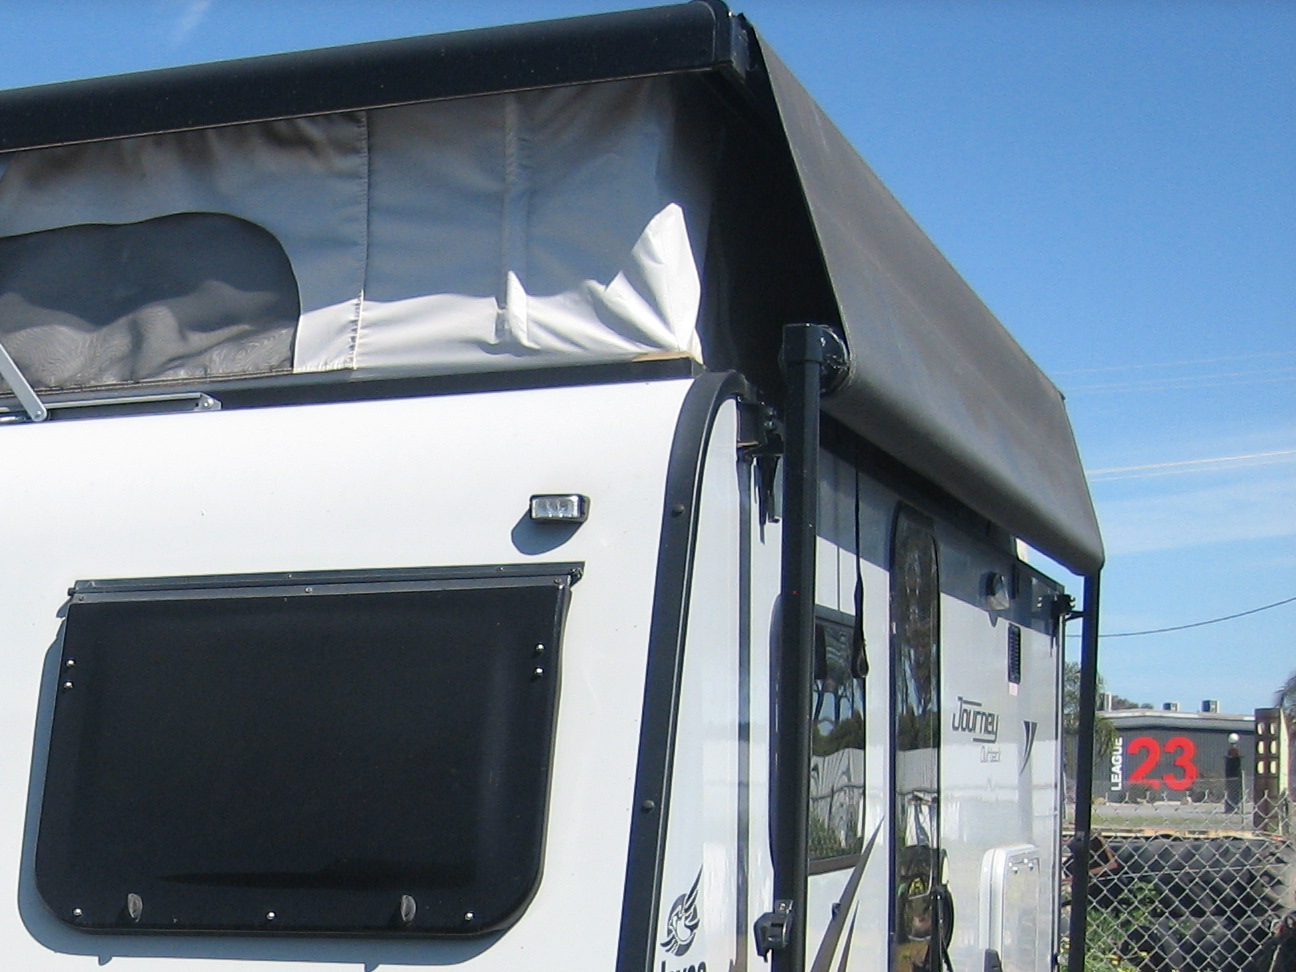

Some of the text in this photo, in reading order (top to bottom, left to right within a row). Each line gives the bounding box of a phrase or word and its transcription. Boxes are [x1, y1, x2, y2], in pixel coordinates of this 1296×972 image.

[952, 696, 999, 743] Journey
[1111, 737, 1123, 791] LEAGUE
[1127, 736, 1198, 791] 23
